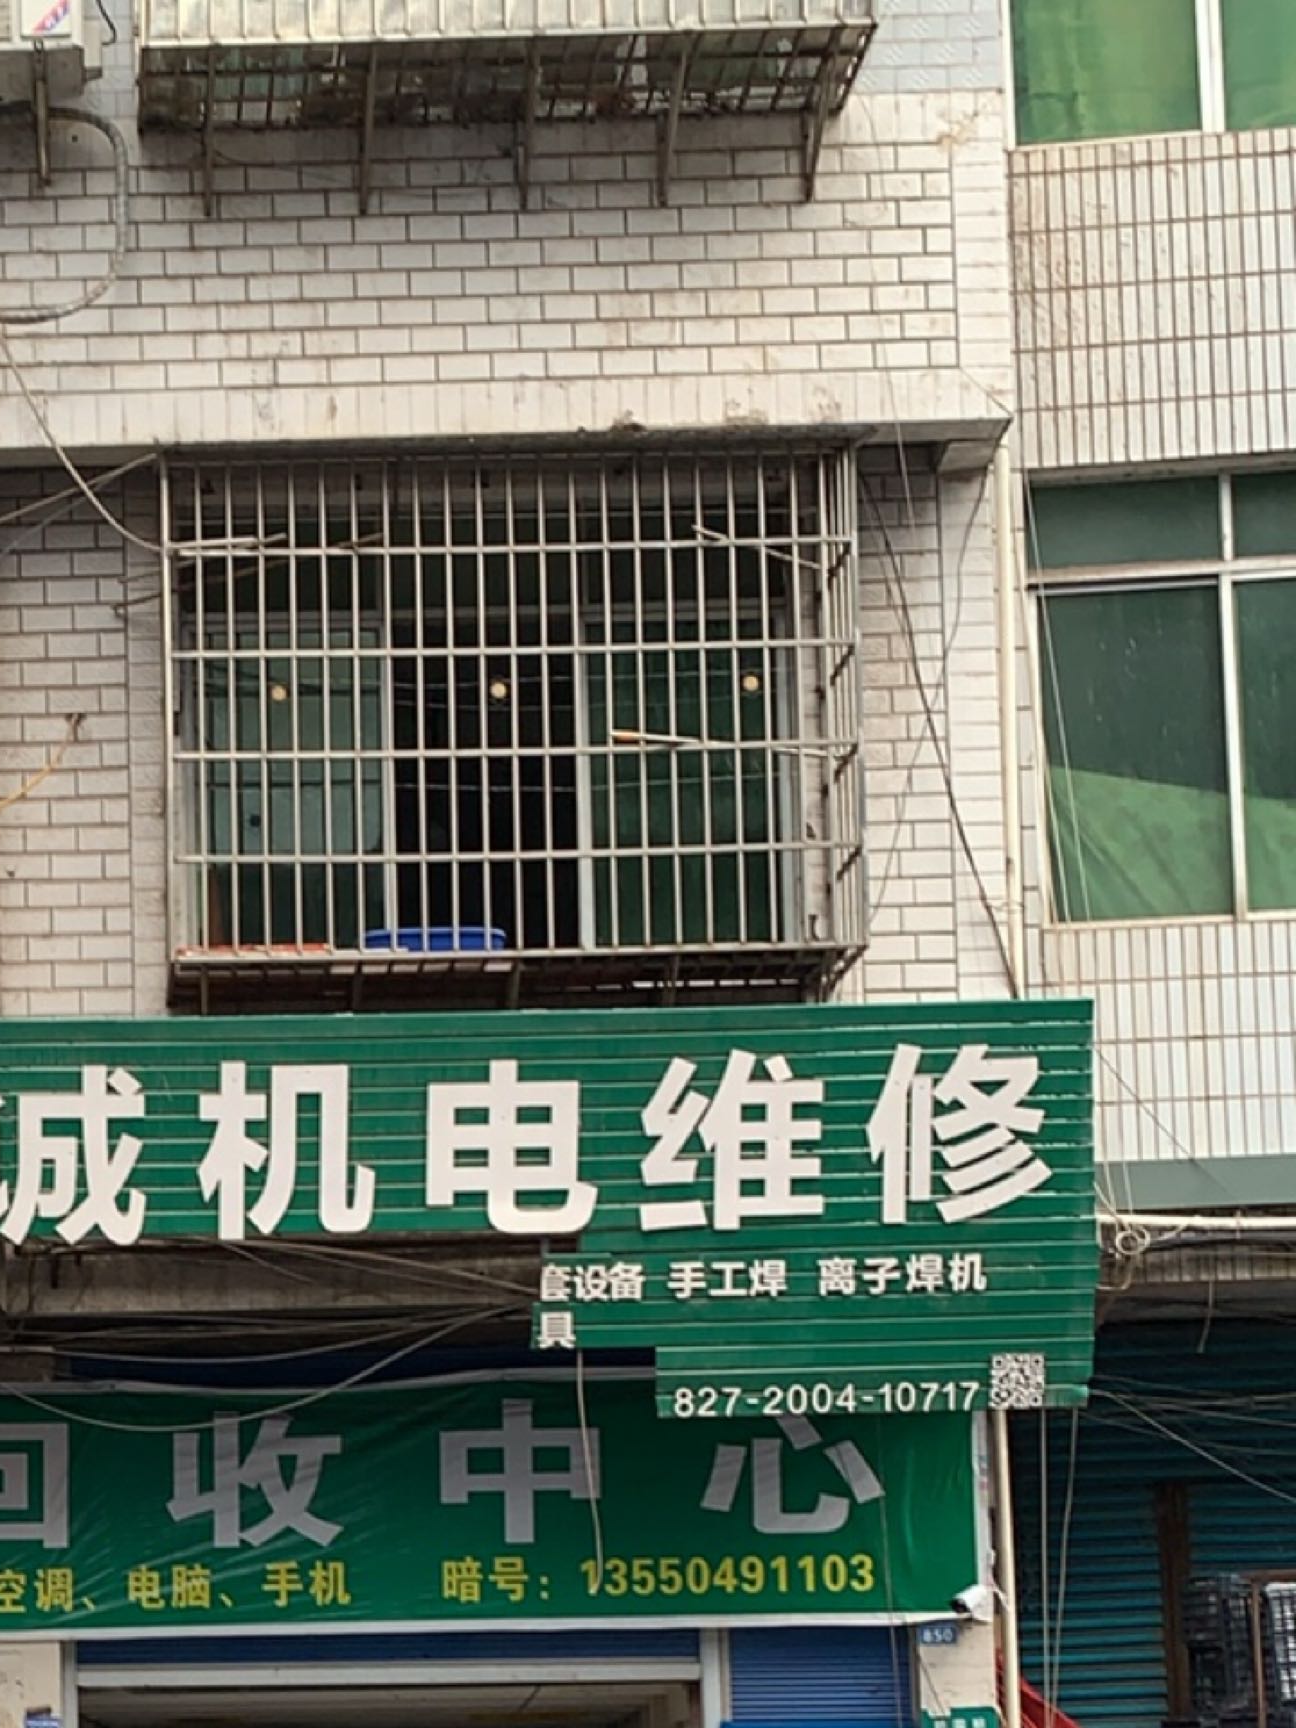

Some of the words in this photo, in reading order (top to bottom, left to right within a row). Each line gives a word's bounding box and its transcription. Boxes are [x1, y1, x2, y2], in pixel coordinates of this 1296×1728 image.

[667, 1260, 787, 1299] 手工焊
[817, 1253, 988, 1296] 离子焊机
[538, 1311, 576, 1349] 具
[673, 1381, 980, 1419] 827-2004-10717
